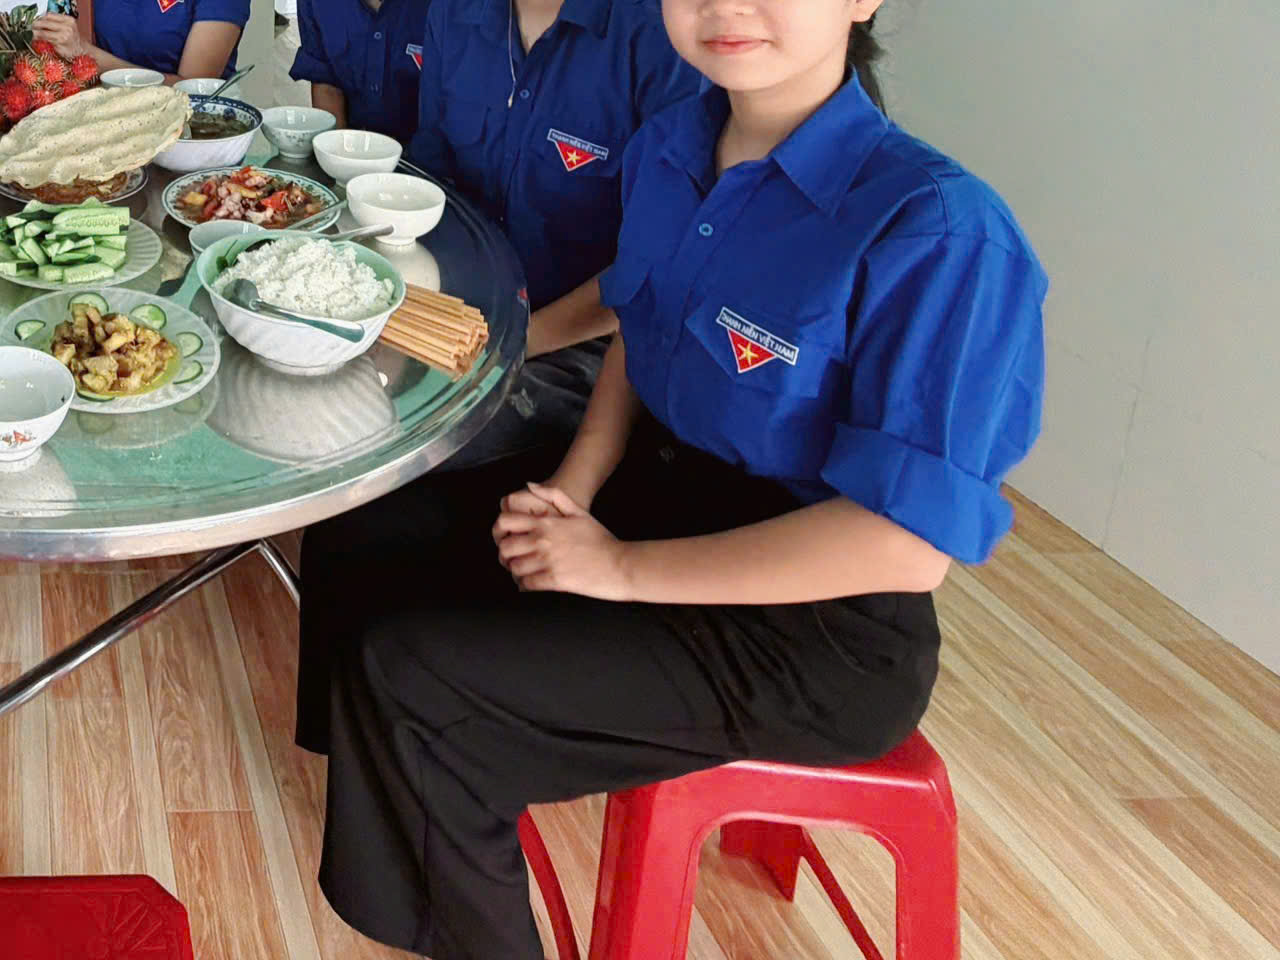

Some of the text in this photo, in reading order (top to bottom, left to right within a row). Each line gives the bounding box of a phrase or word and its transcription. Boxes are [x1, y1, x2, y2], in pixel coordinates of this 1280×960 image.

[741, 325, 758, 340] NIÊN
[759, 333, 775, 348] VIỆT
[775, 344, 795, 360] NAM
